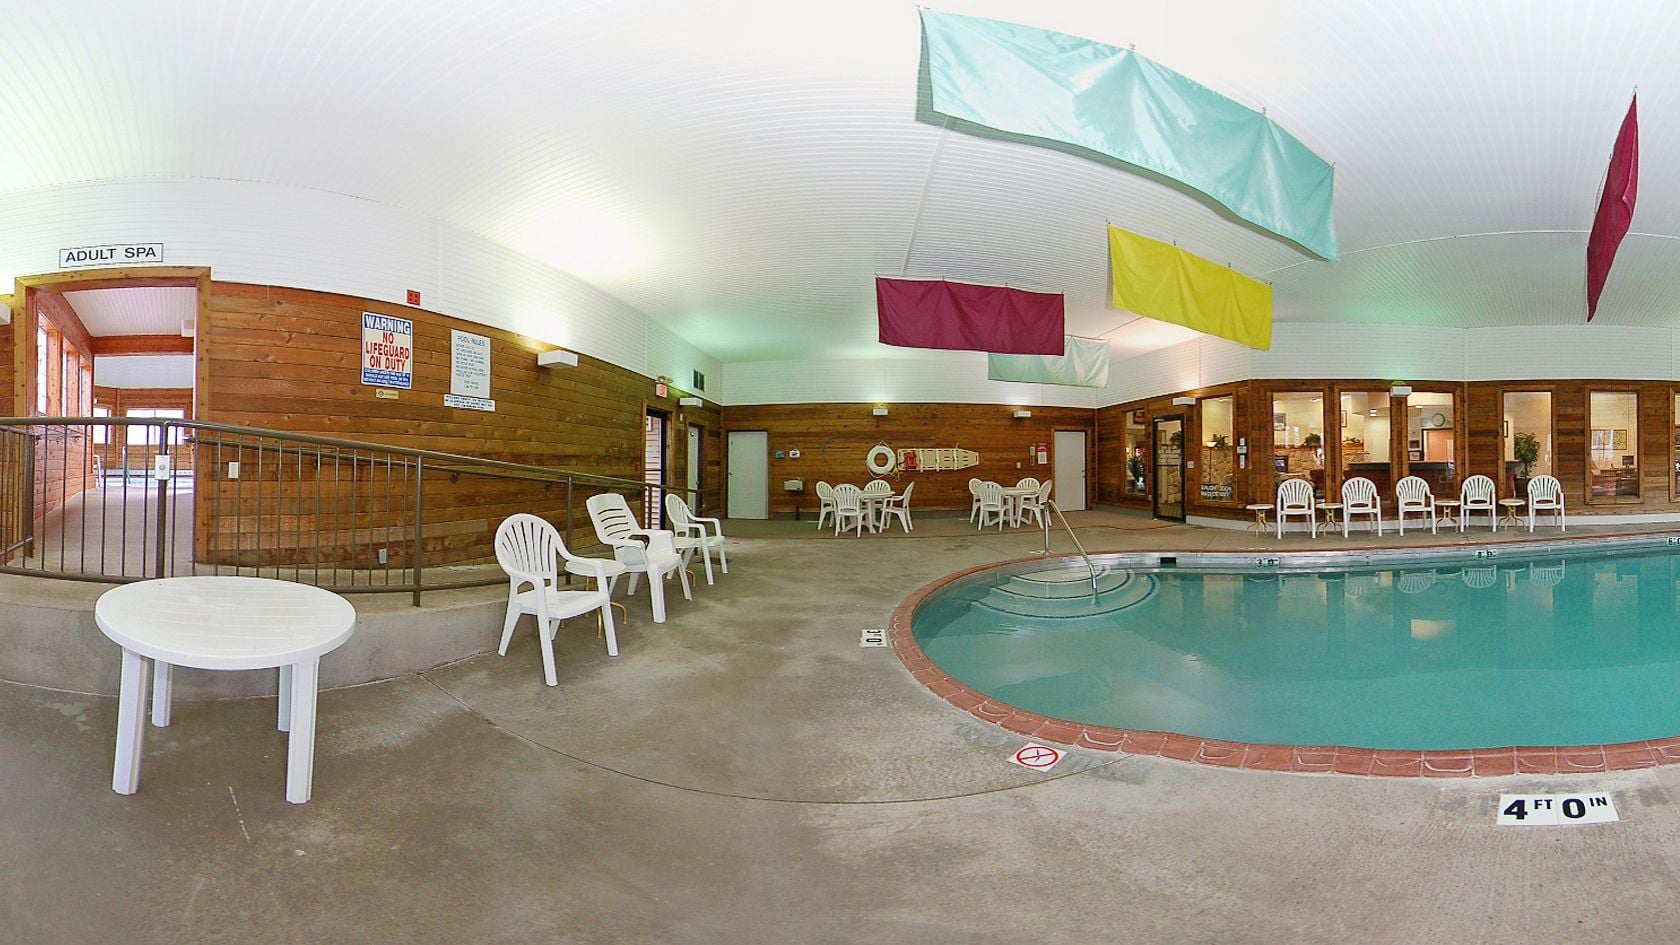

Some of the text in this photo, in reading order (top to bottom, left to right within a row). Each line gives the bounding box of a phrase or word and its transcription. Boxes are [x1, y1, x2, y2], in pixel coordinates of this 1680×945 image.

[65, 247, 157, 263] ADULT SPA
[365, 315, 410, 335] WARNING
[382, 331, 394, 344] NO
[365, 341, 410, 360] LIFEGUARD
[369, 355, 407, 372] ON DUTY
[1503, 797, 1608, 820] 4 FT 0 IN
